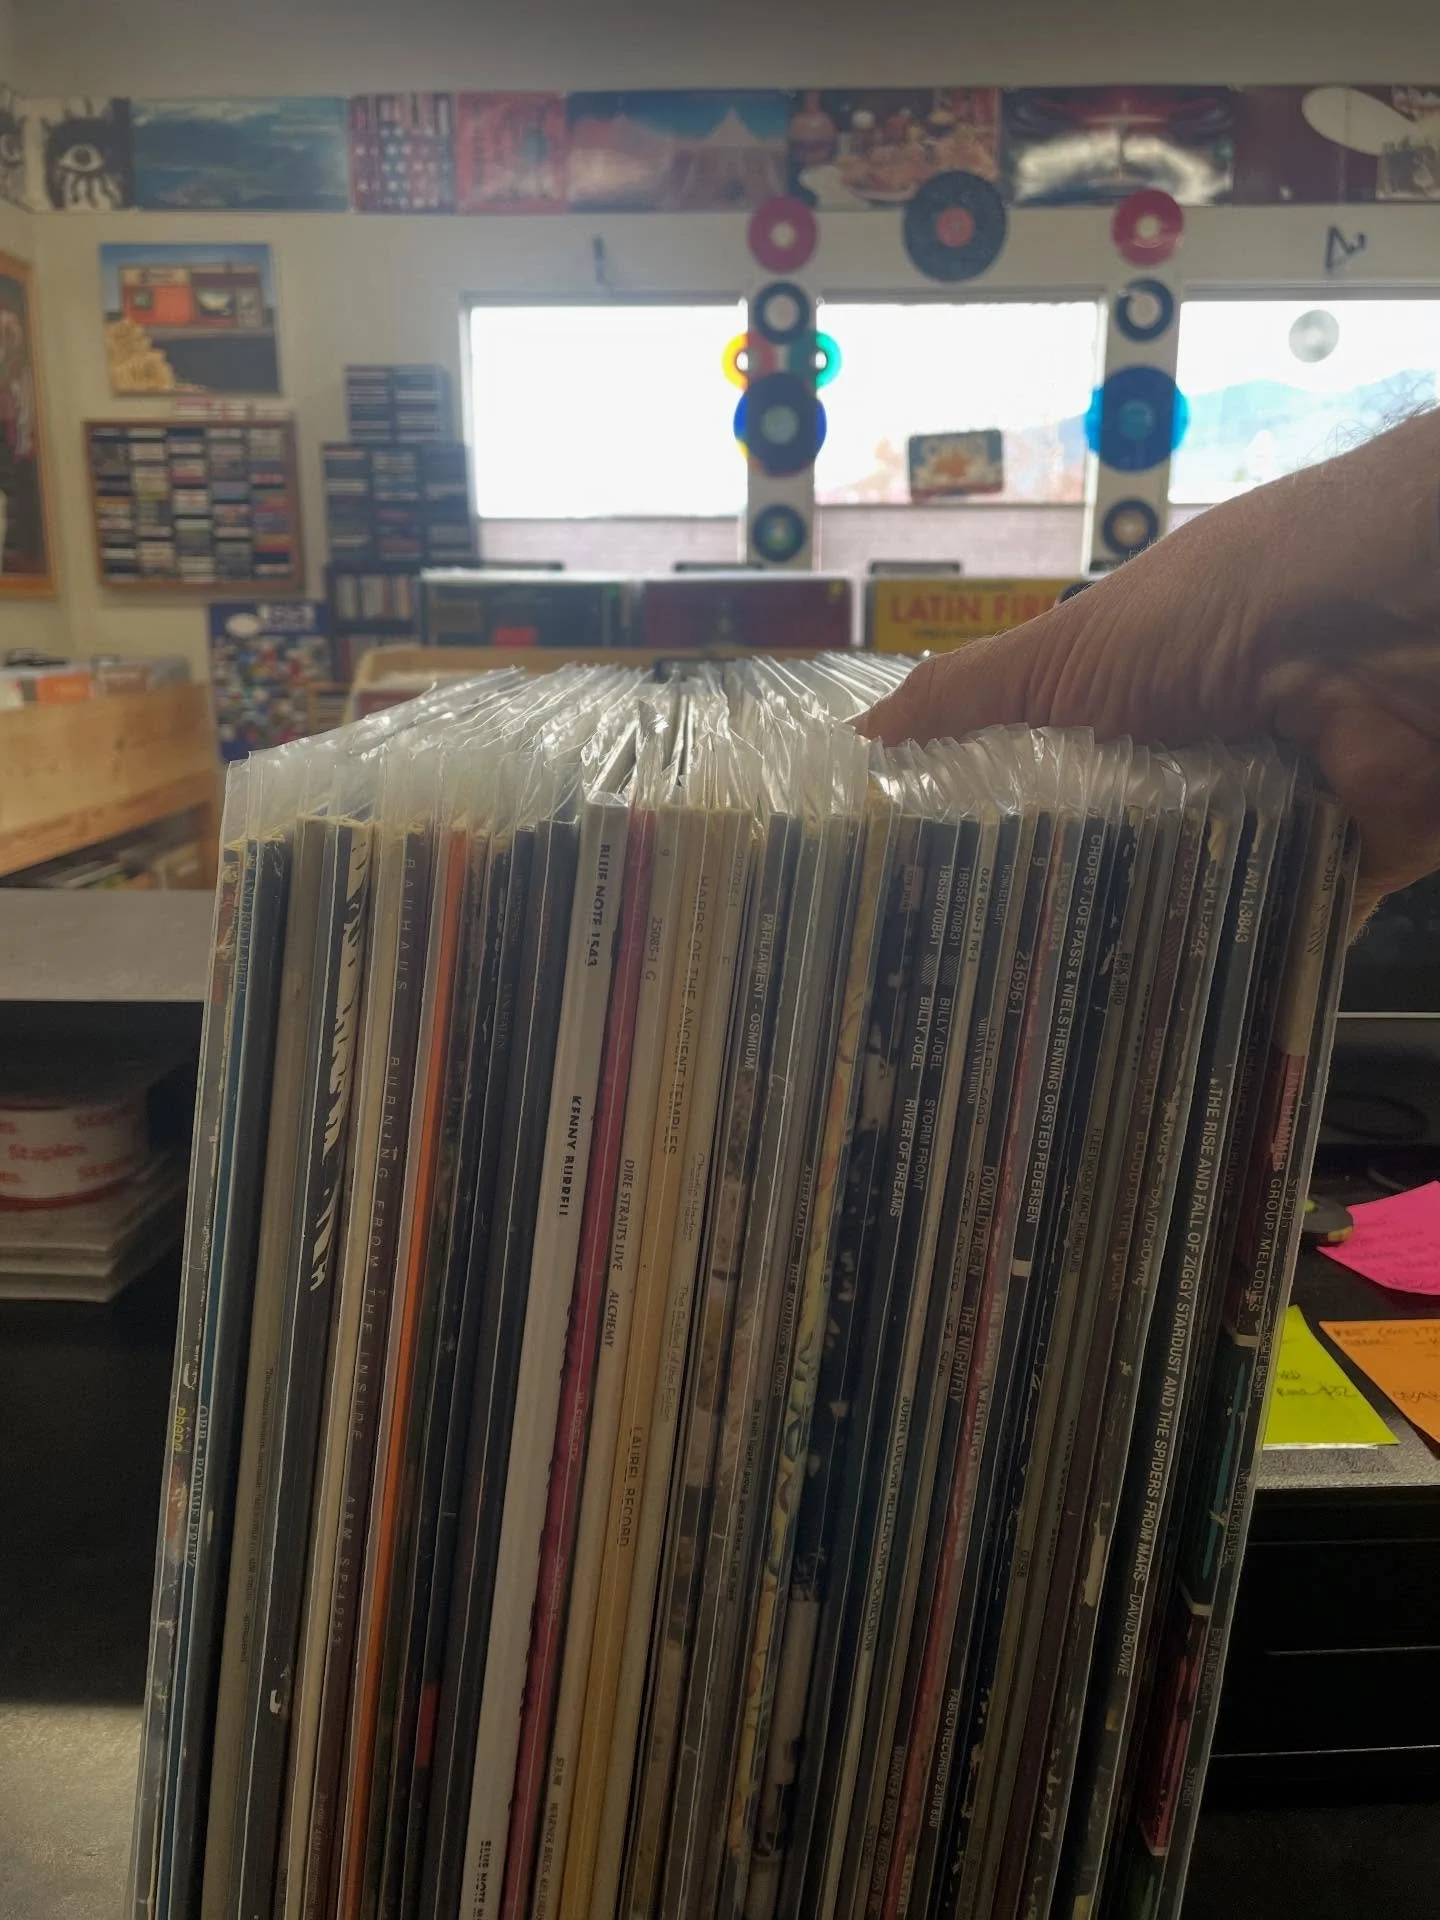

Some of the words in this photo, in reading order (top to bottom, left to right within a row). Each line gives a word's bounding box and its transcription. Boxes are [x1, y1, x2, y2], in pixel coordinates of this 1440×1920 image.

[889, 594, 981, 625] LATIN
[595, 843, 610, 880] BLUE
[1031, 856, 1047, 866] 9
[1080, 833, 1101, 886] CHOPS
[395, 858, 416, 992] BAUHAUS
[590, 884, 606, 925] NOTE
[688, 875, 710, 932] HARPS
[1073, 898, 1091, 925] JOE
[1233, 868, 1260, 943] AYL1-3843
[586, 932, 601, 966] 1543
[684, 938, 702, 960] OF
[751, 912, 774, 1000] PARLIAMENT
[1066, 929, 1086, 967] PASS
[680, 968, 699, 1000] THE
[1005, 950, 1031, 1015] 23696-1
[1064, 970, 1079, 980] &
[915, 996, 932, 1033] BILLY
[934, 997, 951, 1032] BILLY
[1057, 984, 1076, 1024] NIELS
[671, 1006, 694, 1076] ANCIENT
[743, 1012, 762, 1069] OSMIUM
[909, 1035, 926, 1070] JOEL
[928, 1035, 945, 1070] JOEL
[972, 1018, 988, 1054] NIRVANA
[1046, 1027, 1069, 1089] HENNING
[1147, 1027, 1163, 1059] BOB
[965, 1056, 983, 1104] NEVERMIND
[1138, 1060, 1157, 1116] DYLAN
[1204, 1088, 1224, 1116] THE
[1282, 1068, 1300, 1097] JAN
[376, 1055, 400, 1179] BURNING
[564, 1095, 581, 1149] KENNY
[662, 1083, 685, 1154] TEMPLES
[899, 1098, 917, 1138] RIVER
[918, 1098, 936, 1144] STORM
[1036, 1093, 1058, 1148] ORSTED
[1197, 1121, 1218, 1157] RISE
[1270, 1103, 1294, 1171] HAMMER
[896, 1140, 911, 1160] OF
[911, 1147, 929, 1190] FRONT
[1080, 1127, 1102, 1192] FLEETWOOD
[1126, 1131, 1146, 1182] BLOOD
[557, 1155, 574, 1215] BURRELL
[620, 1159, 635, 1189] DIRE
[888, 1162, 908, 1216] DREAMS
[958, 1169, 975, 1224] SECRET
[973, 1165, 996, 1225] DONALD
[1023, 1152, 1048, 1223] PEDERSEN
[1122, 1184, 1137, 1207] ON
[1192, 1161, 1212, 1189] AND
[614, 1191, 631, 1242] STRAITS
[793, 1165, 812, 1237] AFTERMATH
[1141, 1188, 1162, 1233] DAVID
[1186, 1193, 1207, 1227] FALL
[367, 1199, 386, 1268] FROM
[1067, 1222, 1087, 1273] RUMOURS
[1117, 1213, 1133, 1238] THE
[1182, 1232, 1200, 1252] OF
[1246, 1177, 1282, 1312] GROUP/MELODIES
[610, 1244, 625, 1271] LIVE
[787, 1263, 799, 1285] THE
[965, 1227, 987, 1276] FAGEN
[1107, 1243, 1128, 1301] TRACKS
[1132, 1237, 1154, 1286] BOWIE
[1175, 1255, 1197, 1299] ZIGGY
[361, 1287, 377, 1332] THE
[602, 1290, 620, 1347] ALCHEMY
[957, 1304, 976, 1333] THE
[987, 1293, 1003, 1323] THE
[1163, 1302, 1189, 1373] STARDUST
[947, 1335, 971, 1401] NIGHTFLY
[1251, 1365, 1267, 1398] BUSH
[350, 1351, 370, 1439] INSIDE
[896, 1395, 911, 1432] JOHN
[1158, 1377, 1177, 1406] AND
[1153, 1409, 1172, 1437] THE
[623, 1425, 643, 1479] LAUREL
[887, 1435, 905, 1489] COUGAR
[1143, 1438, 1167, 1496] SPIDERS
[1232, 1467, 1250, 1506] NEVER
[874, 1491, 897, 1573] MELLENCAMP
[1137, 1500, 1157, 1539] FROM
[862, 1578, 884, 1651] SCARECROW
[1115, 1633, 1135, 1676] BOWIE
[942, 1688, 961, 1726] PABLO
[885, 1745, 904, 1796] WARNER
[933, 1728, 954, 1781] RECORDS
[929, 1783, 946, 1806] 2310
